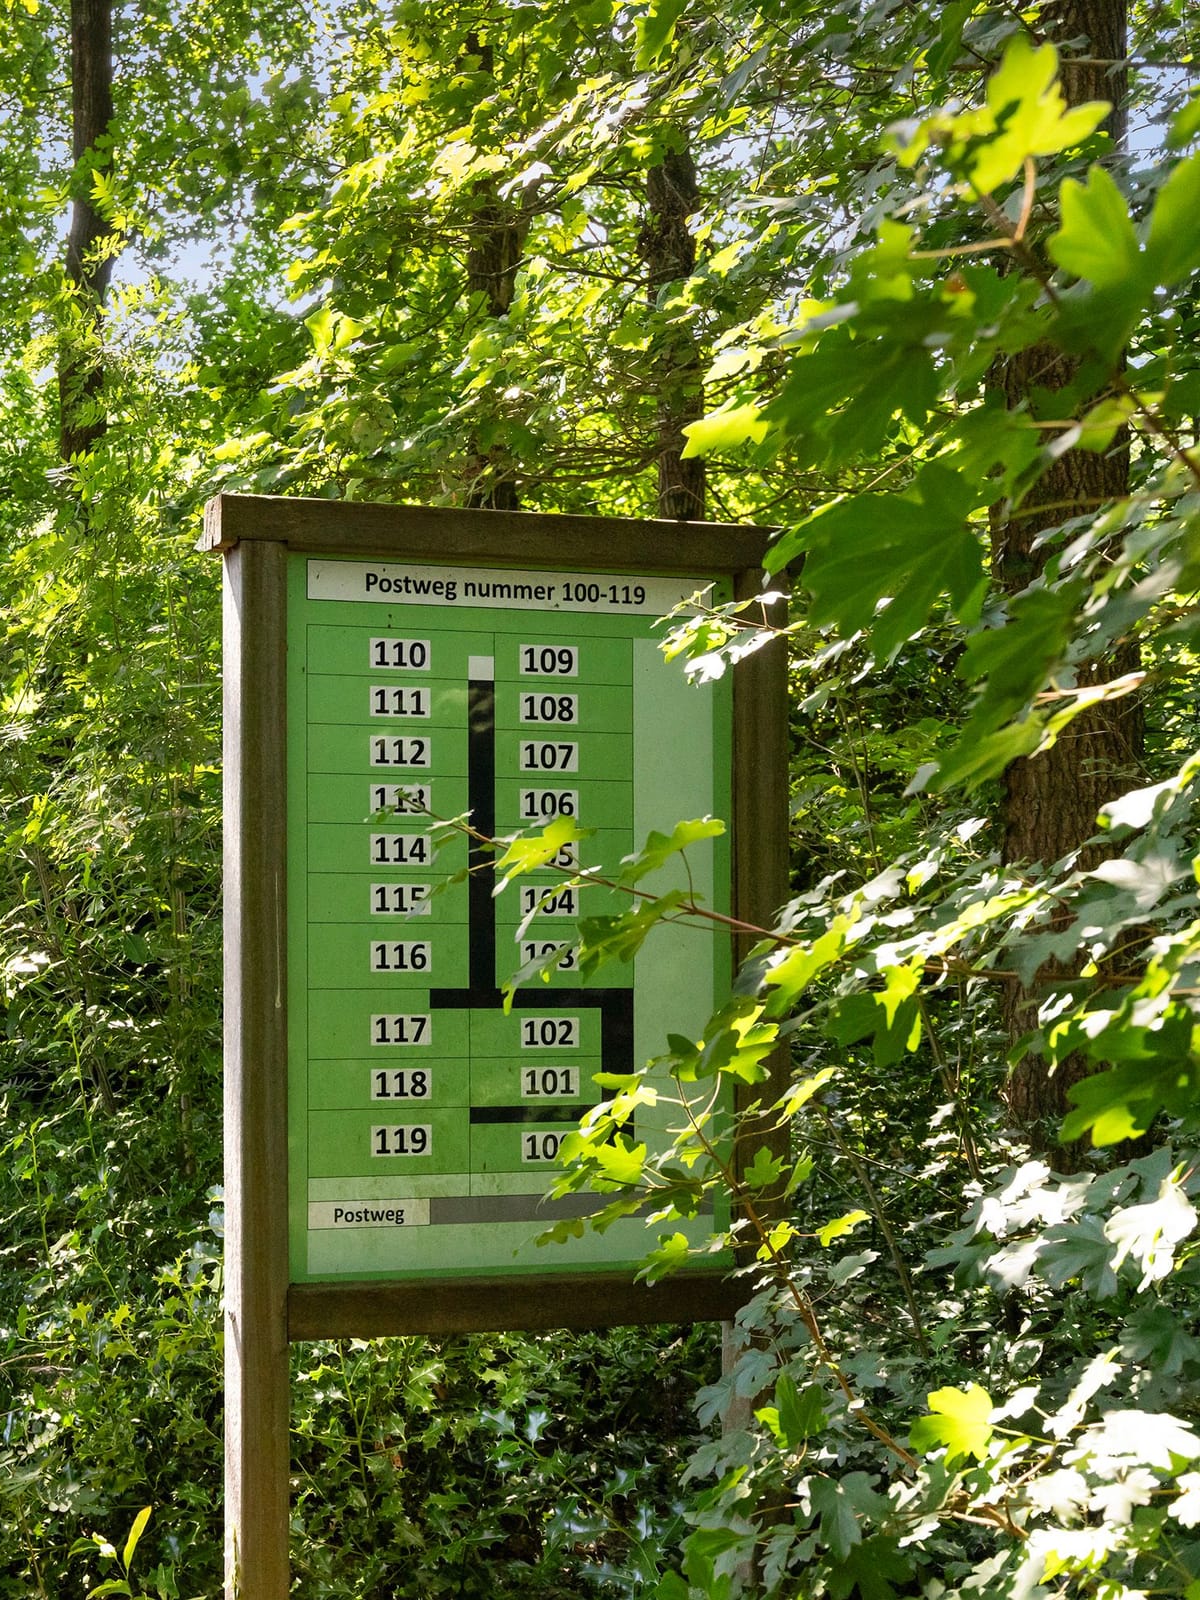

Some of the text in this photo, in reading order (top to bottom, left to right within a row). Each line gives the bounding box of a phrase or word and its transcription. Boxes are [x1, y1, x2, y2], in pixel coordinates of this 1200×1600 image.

[365, 573, 646, 605] Postweg nummer 100-119
[374, 641, 426, 668] 110
[524, 648, 573, 673] 109
[374, 690, 425, 715] 111
[524, 696, 573, 721] 108
[374, 739, 426, 764] 112
[524, 744, 573, 769] 107
[524, 792, 574, 817] 106
[374, 837, 426, 862] 114
[374, 886, 426, 912] 115
[524, 889, 574, 914] 104
[375, 944, 427, 969] 116
[375, 1018, 426, 1043] 117
[524, 1020, 573, 1045] 102
[376, 1071, 427, 1097] 118
[524, 1070, 574, 1094] 101
[376, 1128, 427, 1153] 119
[525, 1134, 568, 1160] 10
[334, 1208, 405, 1224] Postweg
